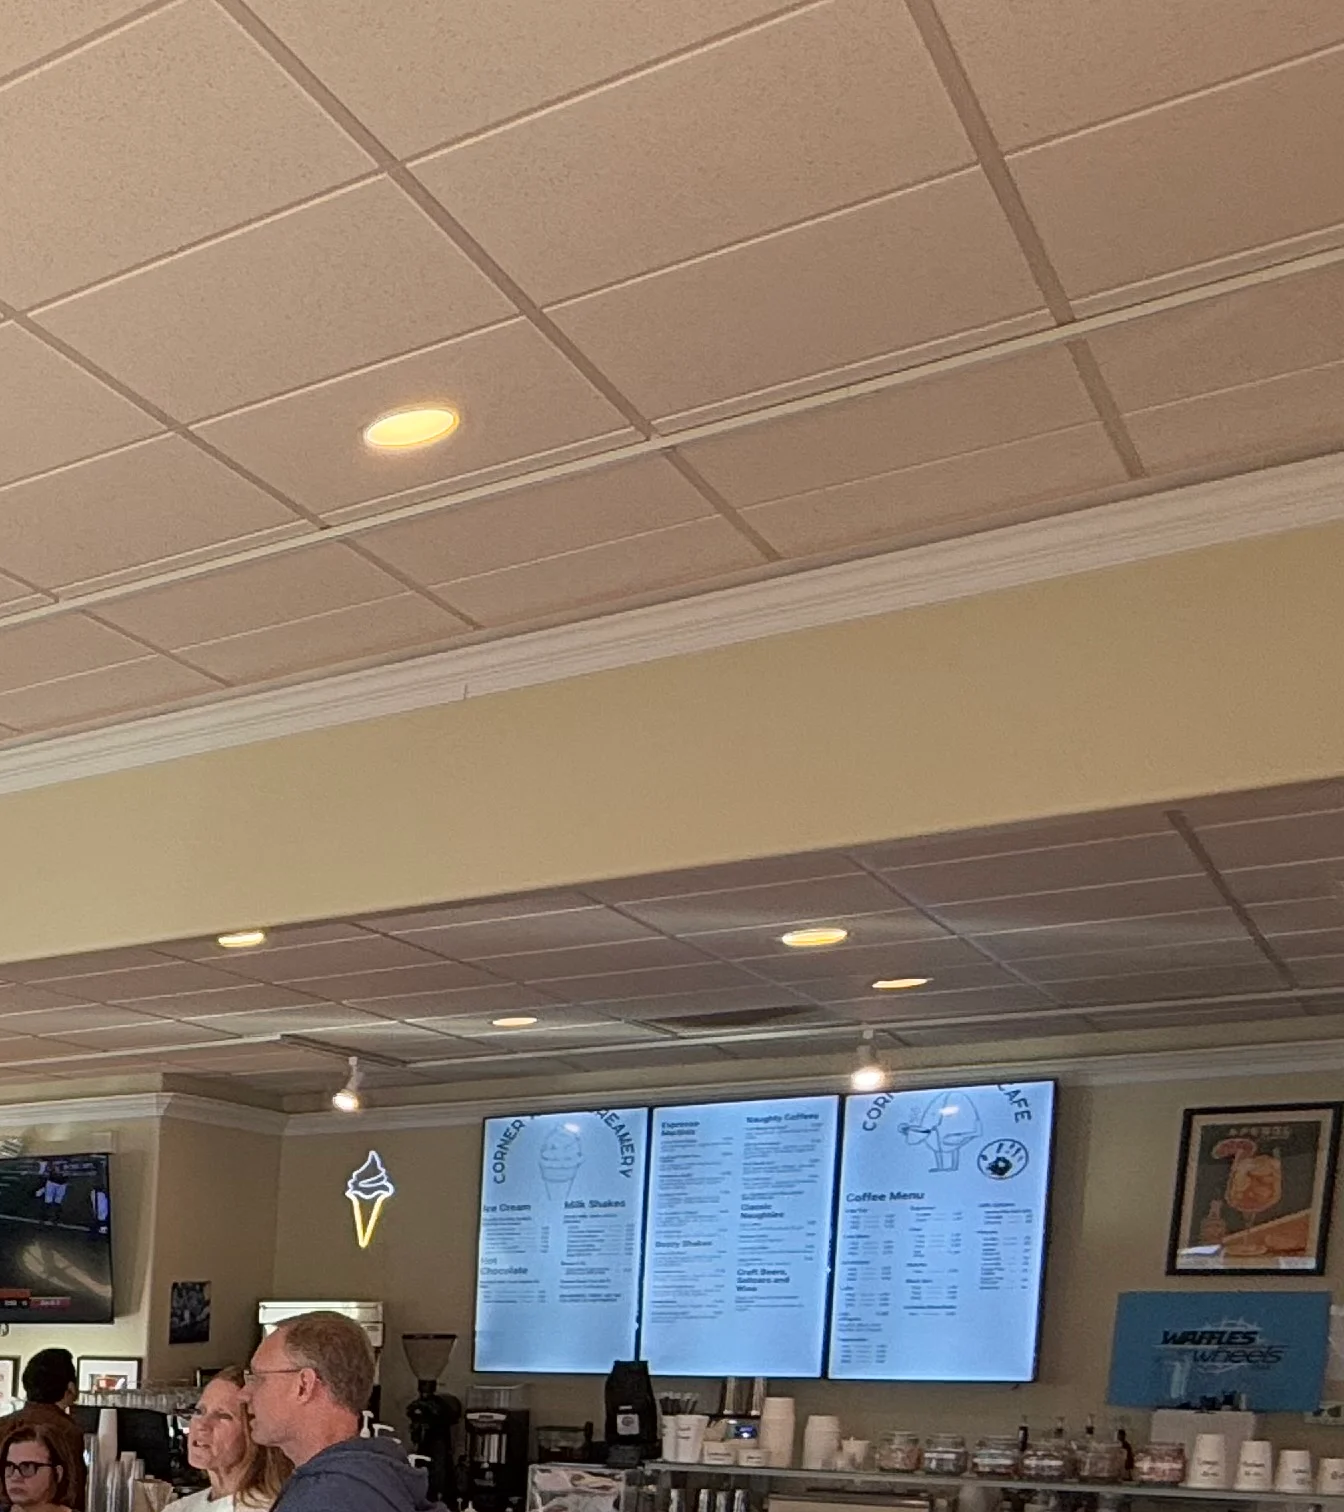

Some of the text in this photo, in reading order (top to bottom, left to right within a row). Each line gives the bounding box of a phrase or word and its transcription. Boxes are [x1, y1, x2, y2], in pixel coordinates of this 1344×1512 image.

[493, 1119, 526, 1184] CORNER
[846, 1191, 925, 1202] Coffee Menu
[499, 1203, 532, 1212] Cream
[564, 1200, 585, 1209] Milk
[480, 1266, 528, 1275] Chocolate
[1160, 1330, 1259, 1345] WAFFLES
